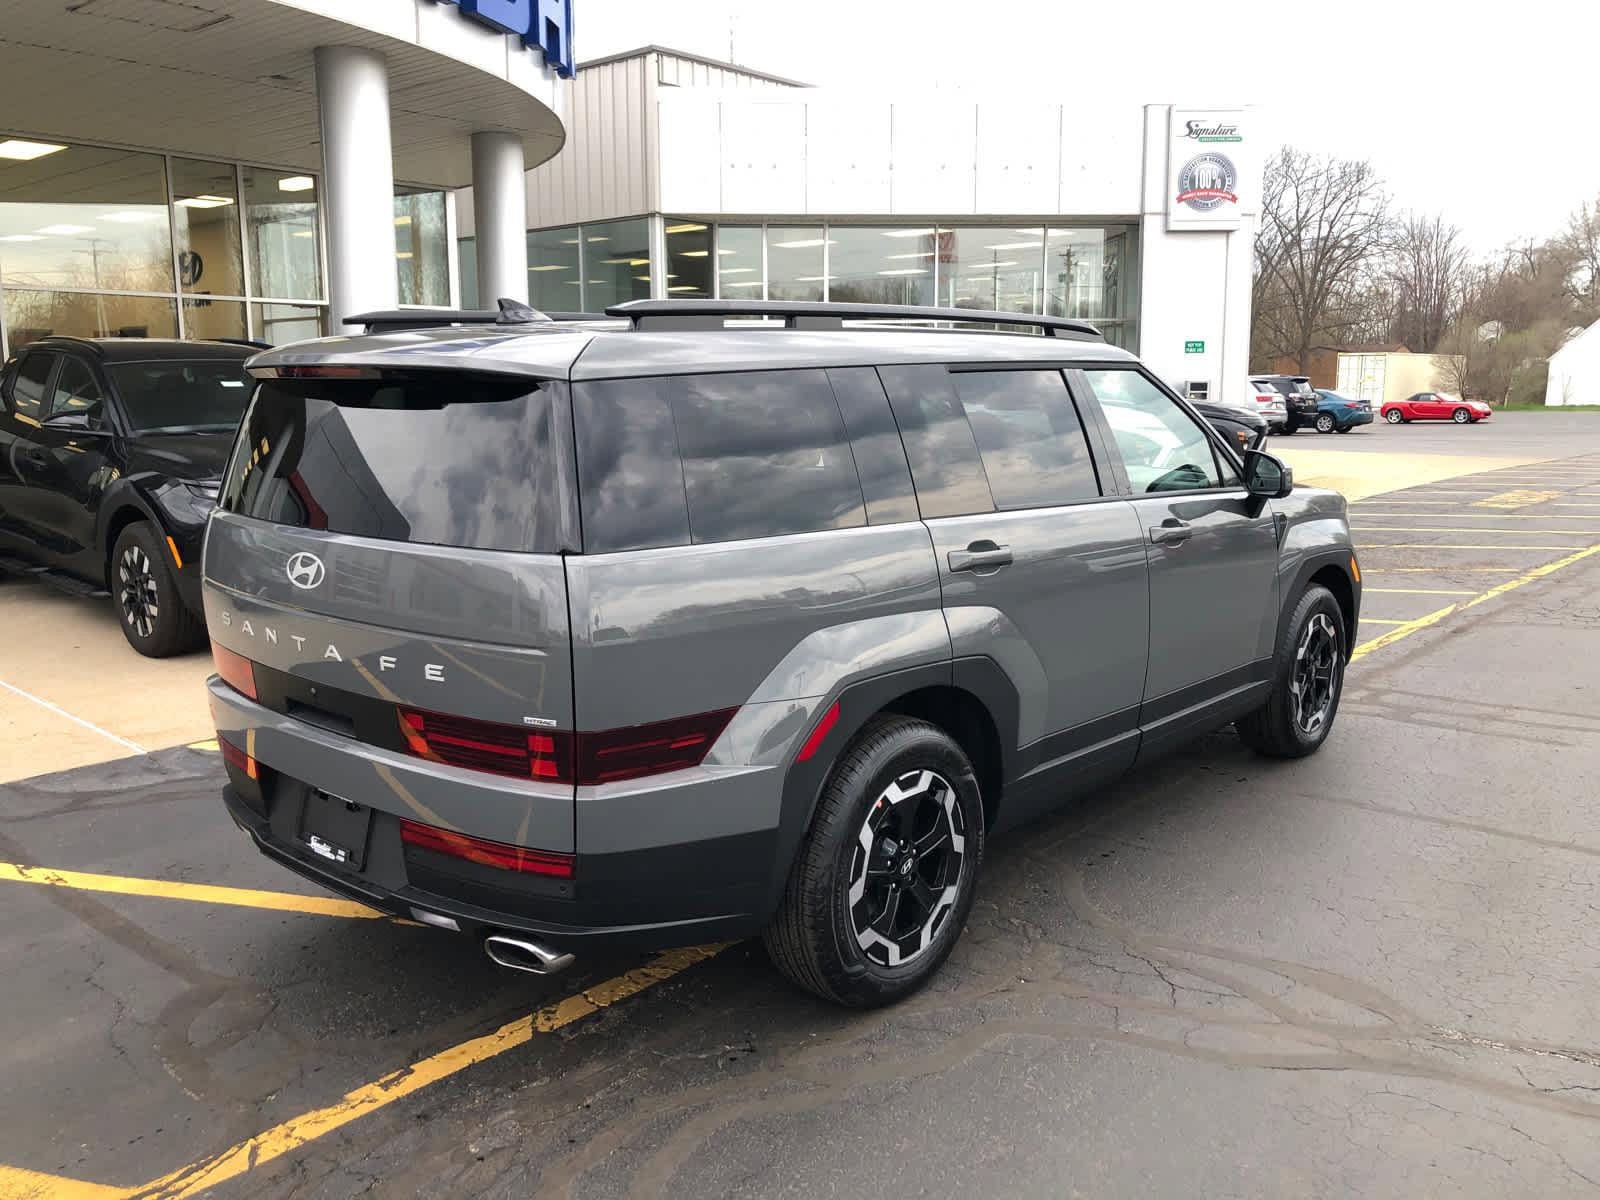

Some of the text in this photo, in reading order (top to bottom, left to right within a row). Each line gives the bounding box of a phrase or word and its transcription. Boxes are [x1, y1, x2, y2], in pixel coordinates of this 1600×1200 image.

[1184, 120, 1238, 139] Signature
[1194, 168, 1222, 189] 100%
[223, 611, 446, 682] SANTA FE
